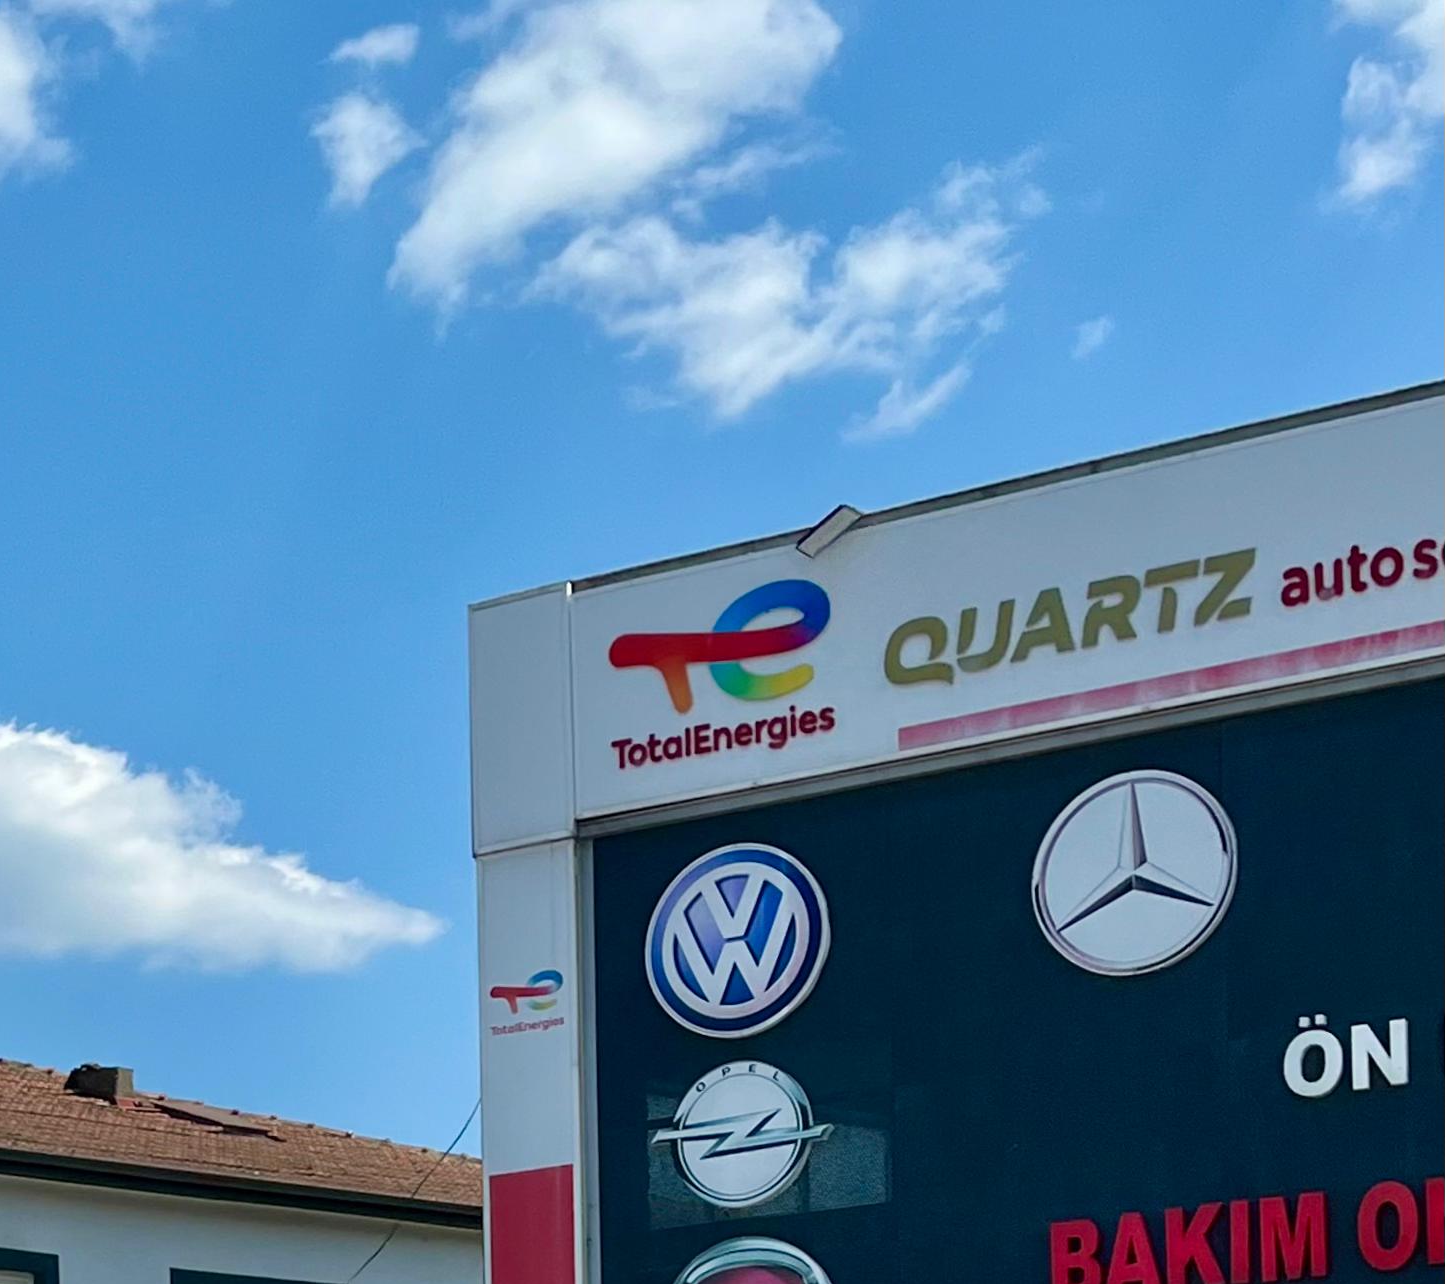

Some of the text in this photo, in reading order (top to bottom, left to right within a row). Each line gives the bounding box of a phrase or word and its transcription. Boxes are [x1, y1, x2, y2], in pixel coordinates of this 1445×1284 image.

[884, 547, 1256, 686] QUARTZ
[611, 705, 836, 770] TotalEnergies
[490, 1017, 564, 1036] TotalEnergies
[1283, 1013, 1410, 1098] ÖN
[695, 1063, 781, 1093] OPEL
